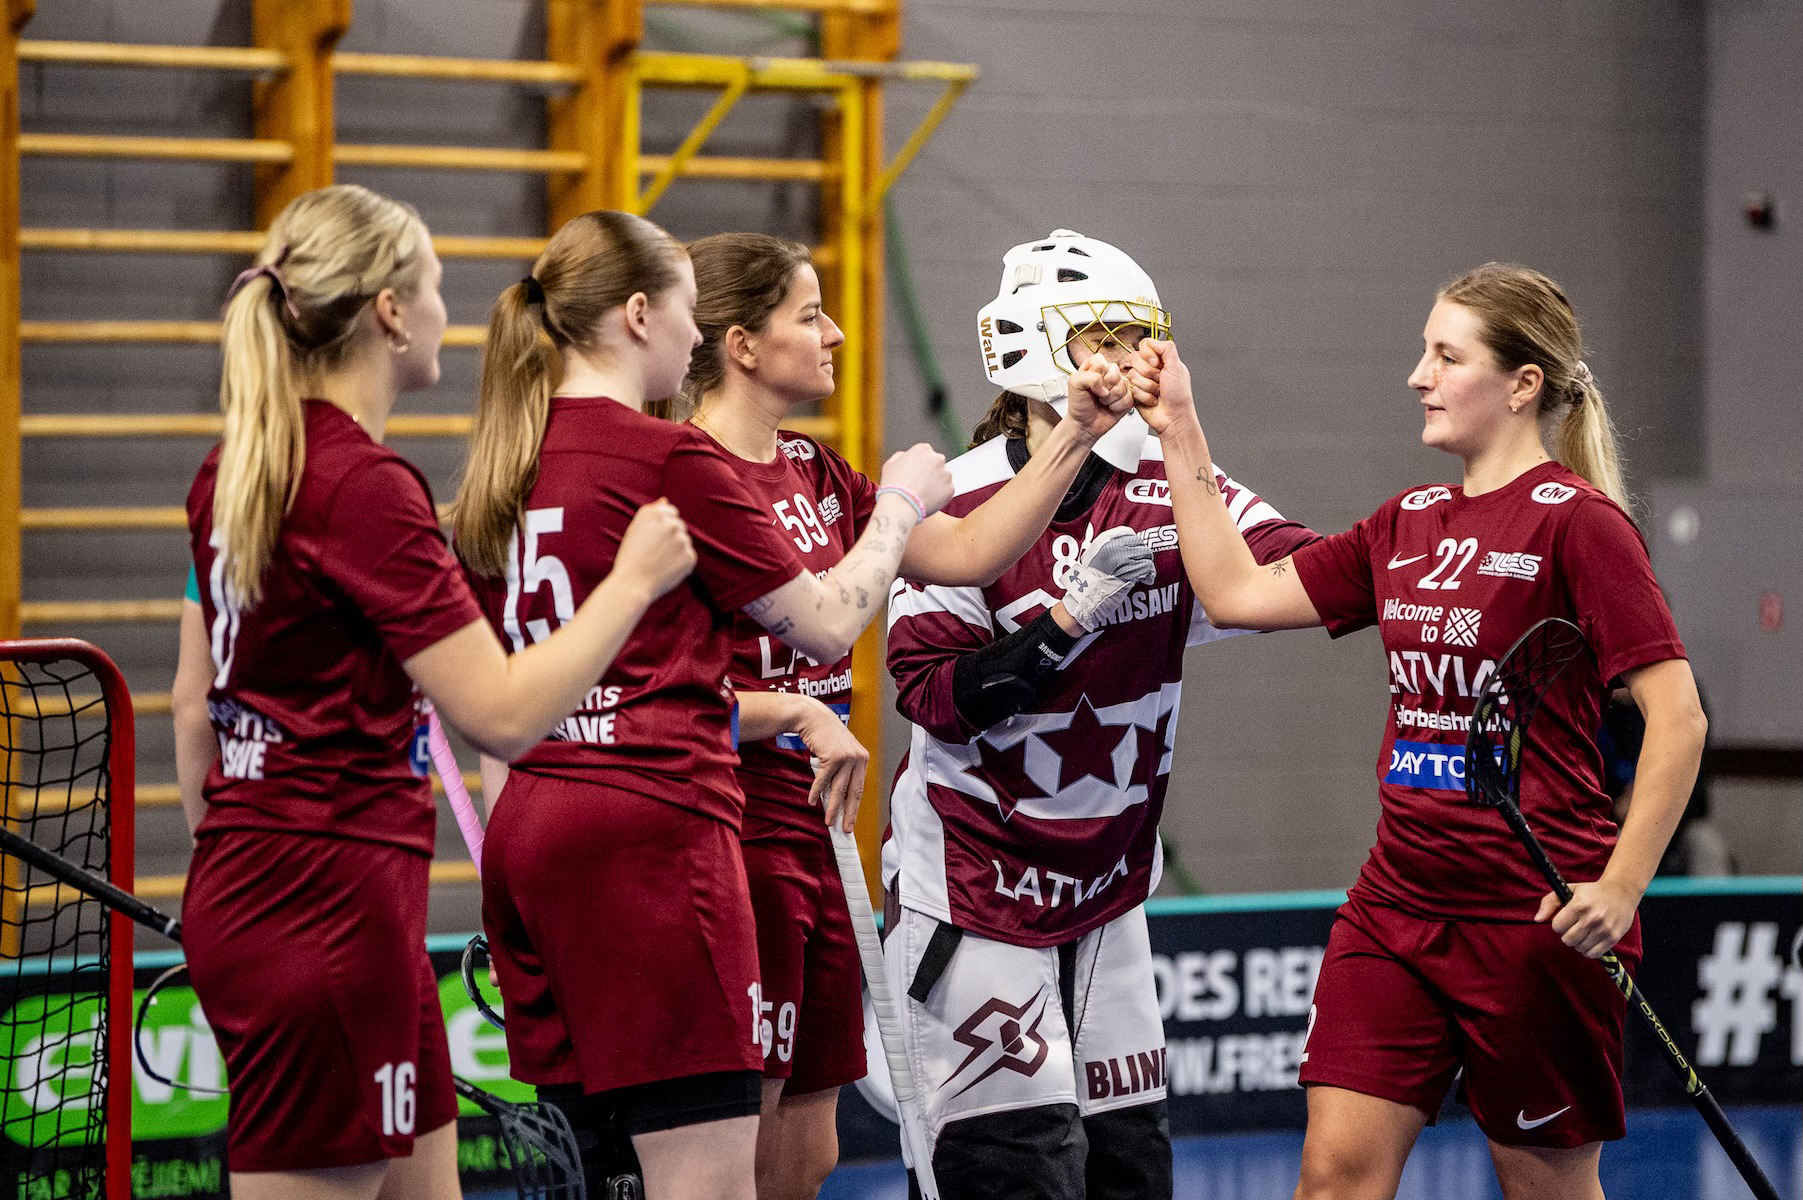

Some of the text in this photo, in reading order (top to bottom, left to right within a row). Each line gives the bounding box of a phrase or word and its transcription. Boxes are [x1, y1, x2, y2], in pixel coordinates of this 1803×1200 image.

[1132, 482, 1171, 499] elv
[772, 493, 829, 553] 59
[1416, 537, 1479, 590] 22
[1382, 597, 1444, 622] Welcome
[1421, 623, 1439, 643] to
[1389, 749, 1467, 779] DAYTO
[374, 1061, 417, 1136] 16
